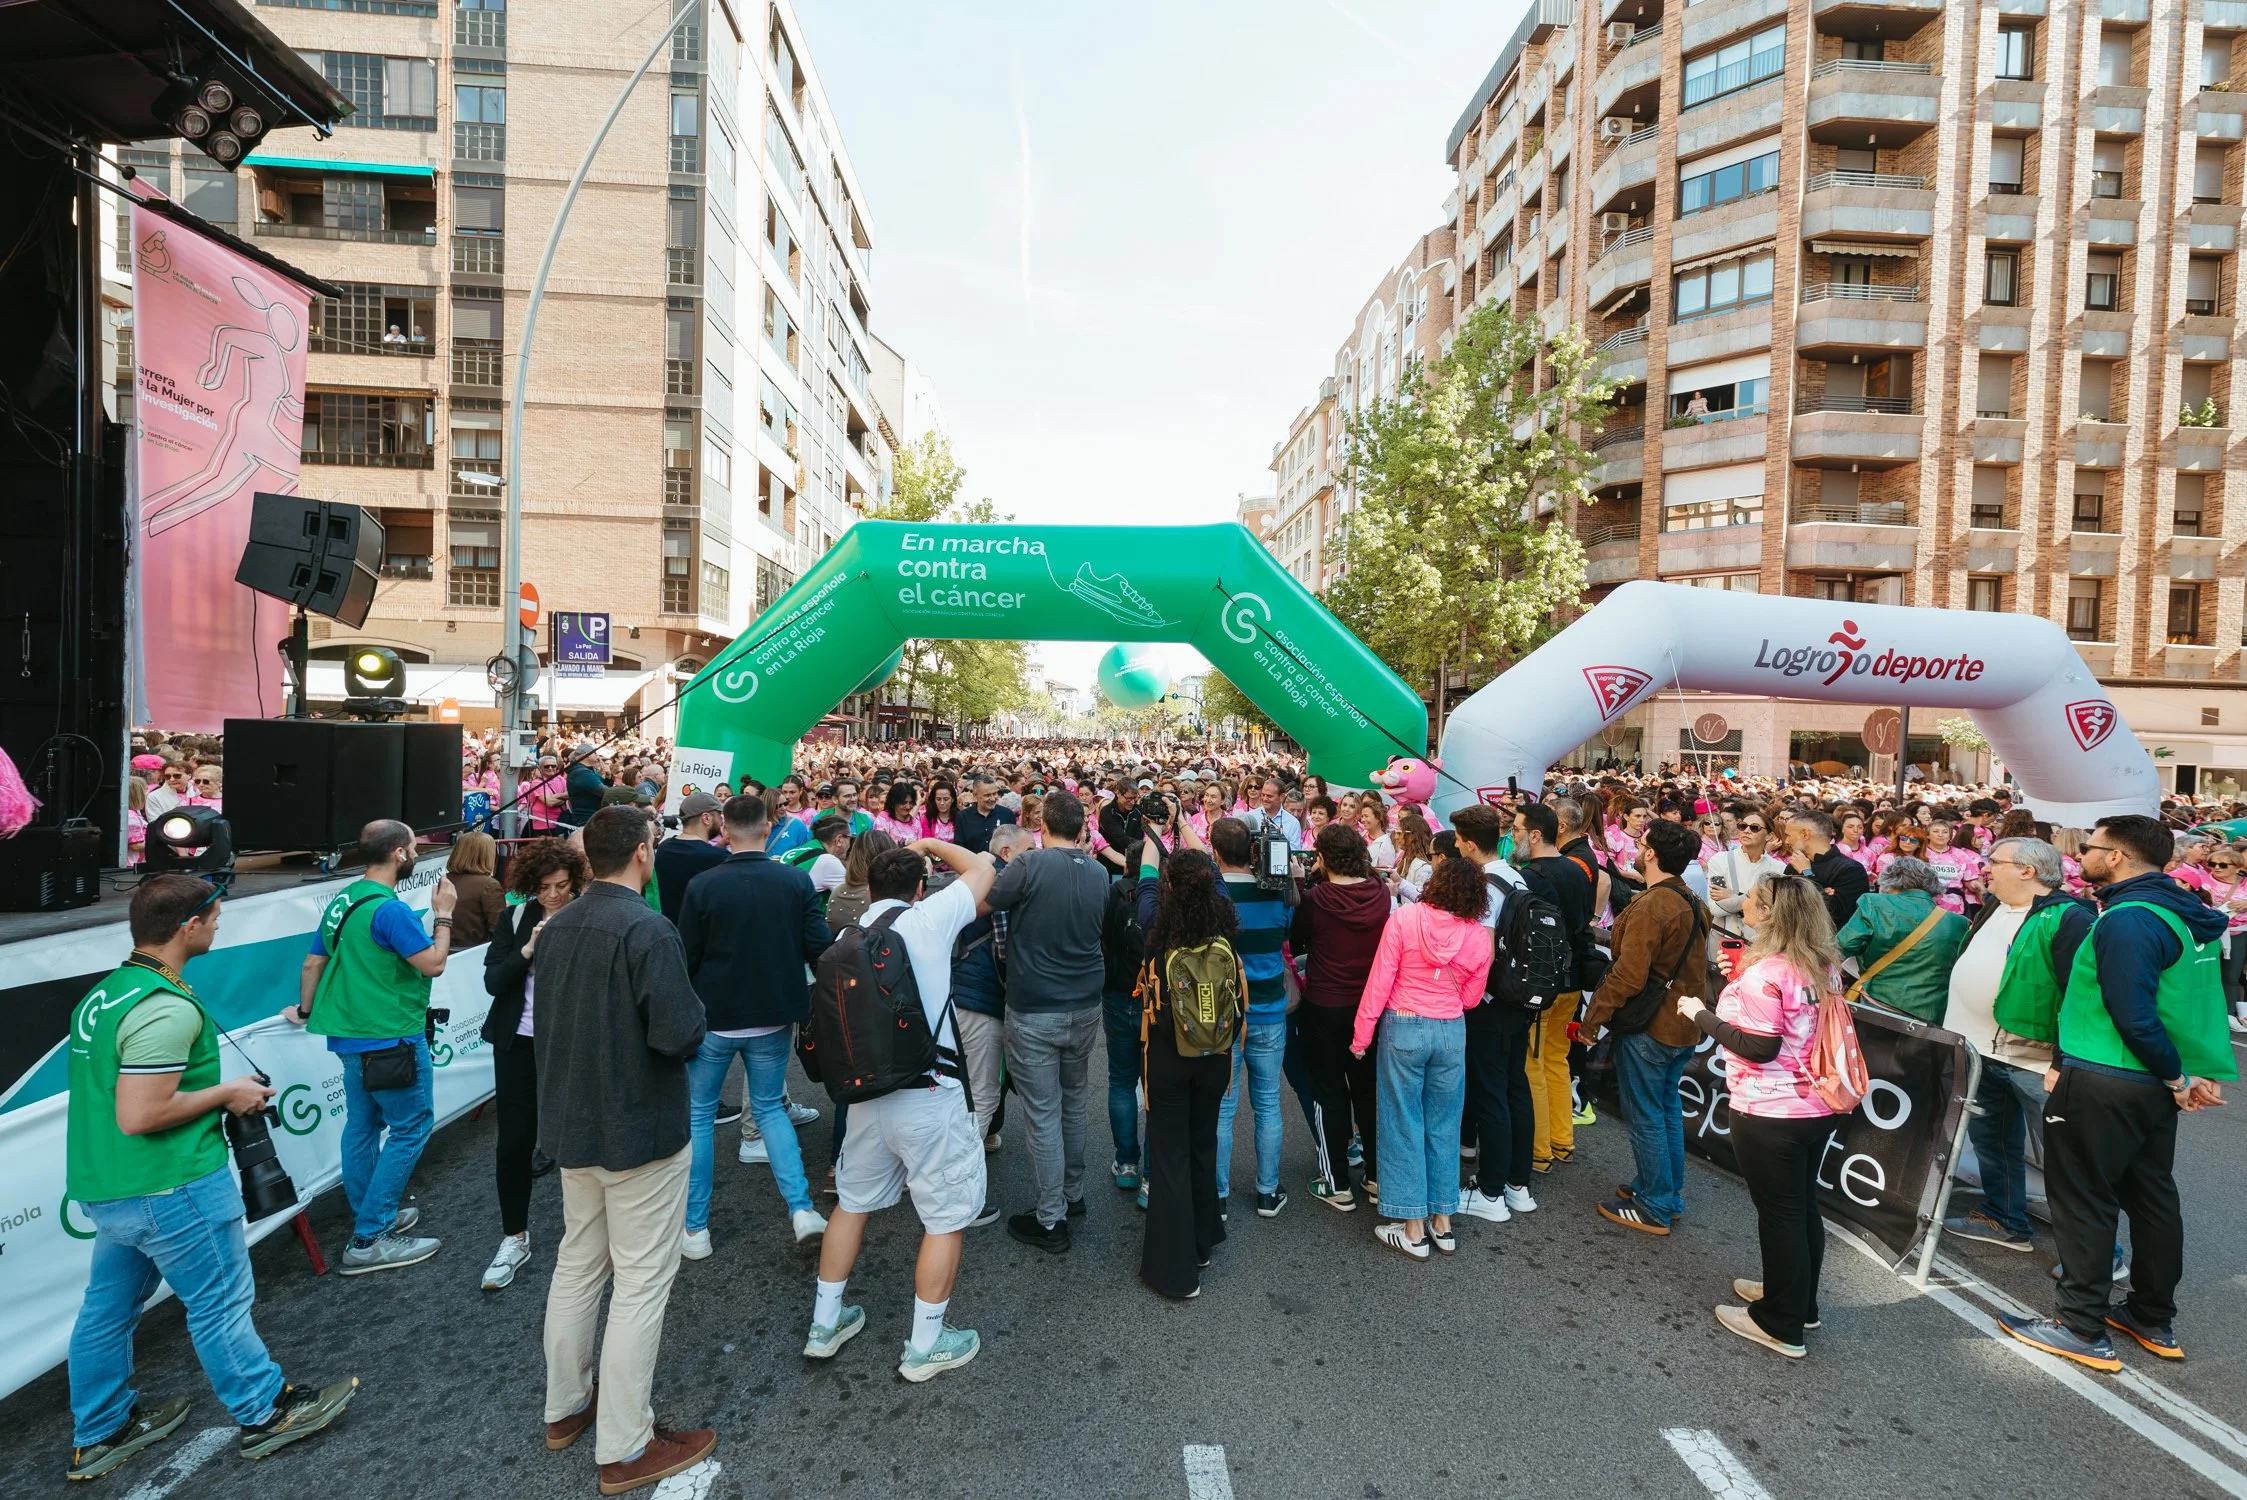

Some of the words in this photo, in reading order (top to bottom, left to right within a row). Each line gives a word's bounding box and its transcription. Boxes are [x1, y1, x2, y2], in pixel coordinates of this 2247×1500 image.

[138, 365, 175, 387] arrera
[146, 379, 158, 393] la
[161, 386, 195, 409] Mujer
[197, 403, 214, 417] por
[141, 392, 218, 431] Investigación
[901, 533, 935, 551] En
[942, 536, 1046, 556] marcha
[898, 557, 987, 581] contra
[800, 572, 848, 613] española
[898, 582, 926, 605] el
[930, 584, 1026, 609] cáncer
[590, 616, 607, 639] P
[756, 636, 790, 665] contra
[789, 626, 801, 638] el
[800, 599, 835, 630] cáncer
[568, 652, 599, 661] SALIDA
[765, 661, 782, 676] en
[778, 650, 798, 664] La
[793, 627, 826, 652] Rioja
[558, 663, 580, 673] LAVADO
[581, 664, 586, 673] A
[1871, 648, 1985, 684] deporte
[1253, 650, 1269, 667] en
[1267, 663, 1282, 682] La
[1280, 678, 1308, 709] Rioja
[1264, 640, 1297, 675] contra
[1295, 673, 1309, 685] el
[1305, 684, 1340, 718] cáncer
[1275, 630, 1326, 684] asociación
[1324, 682, 1369, 729] española
[680, 762, 691, 773] La
[692, 763, 722, 778] Rioja
[1201, 983, 1213, 1022] MUNICH
[450, 1009, 488, 1033] asociación
[455, 1028, 478, 1043] contra
[459, 1046, 470, 1055] en
[468, 1041, 478, 1050] La
[326, 1088, 346, 1102] con
[330, 1104, 344, 1117] en
[1, 1206, 42, 1233] ñola
[929, 1351, 952, 1361] HOKA
